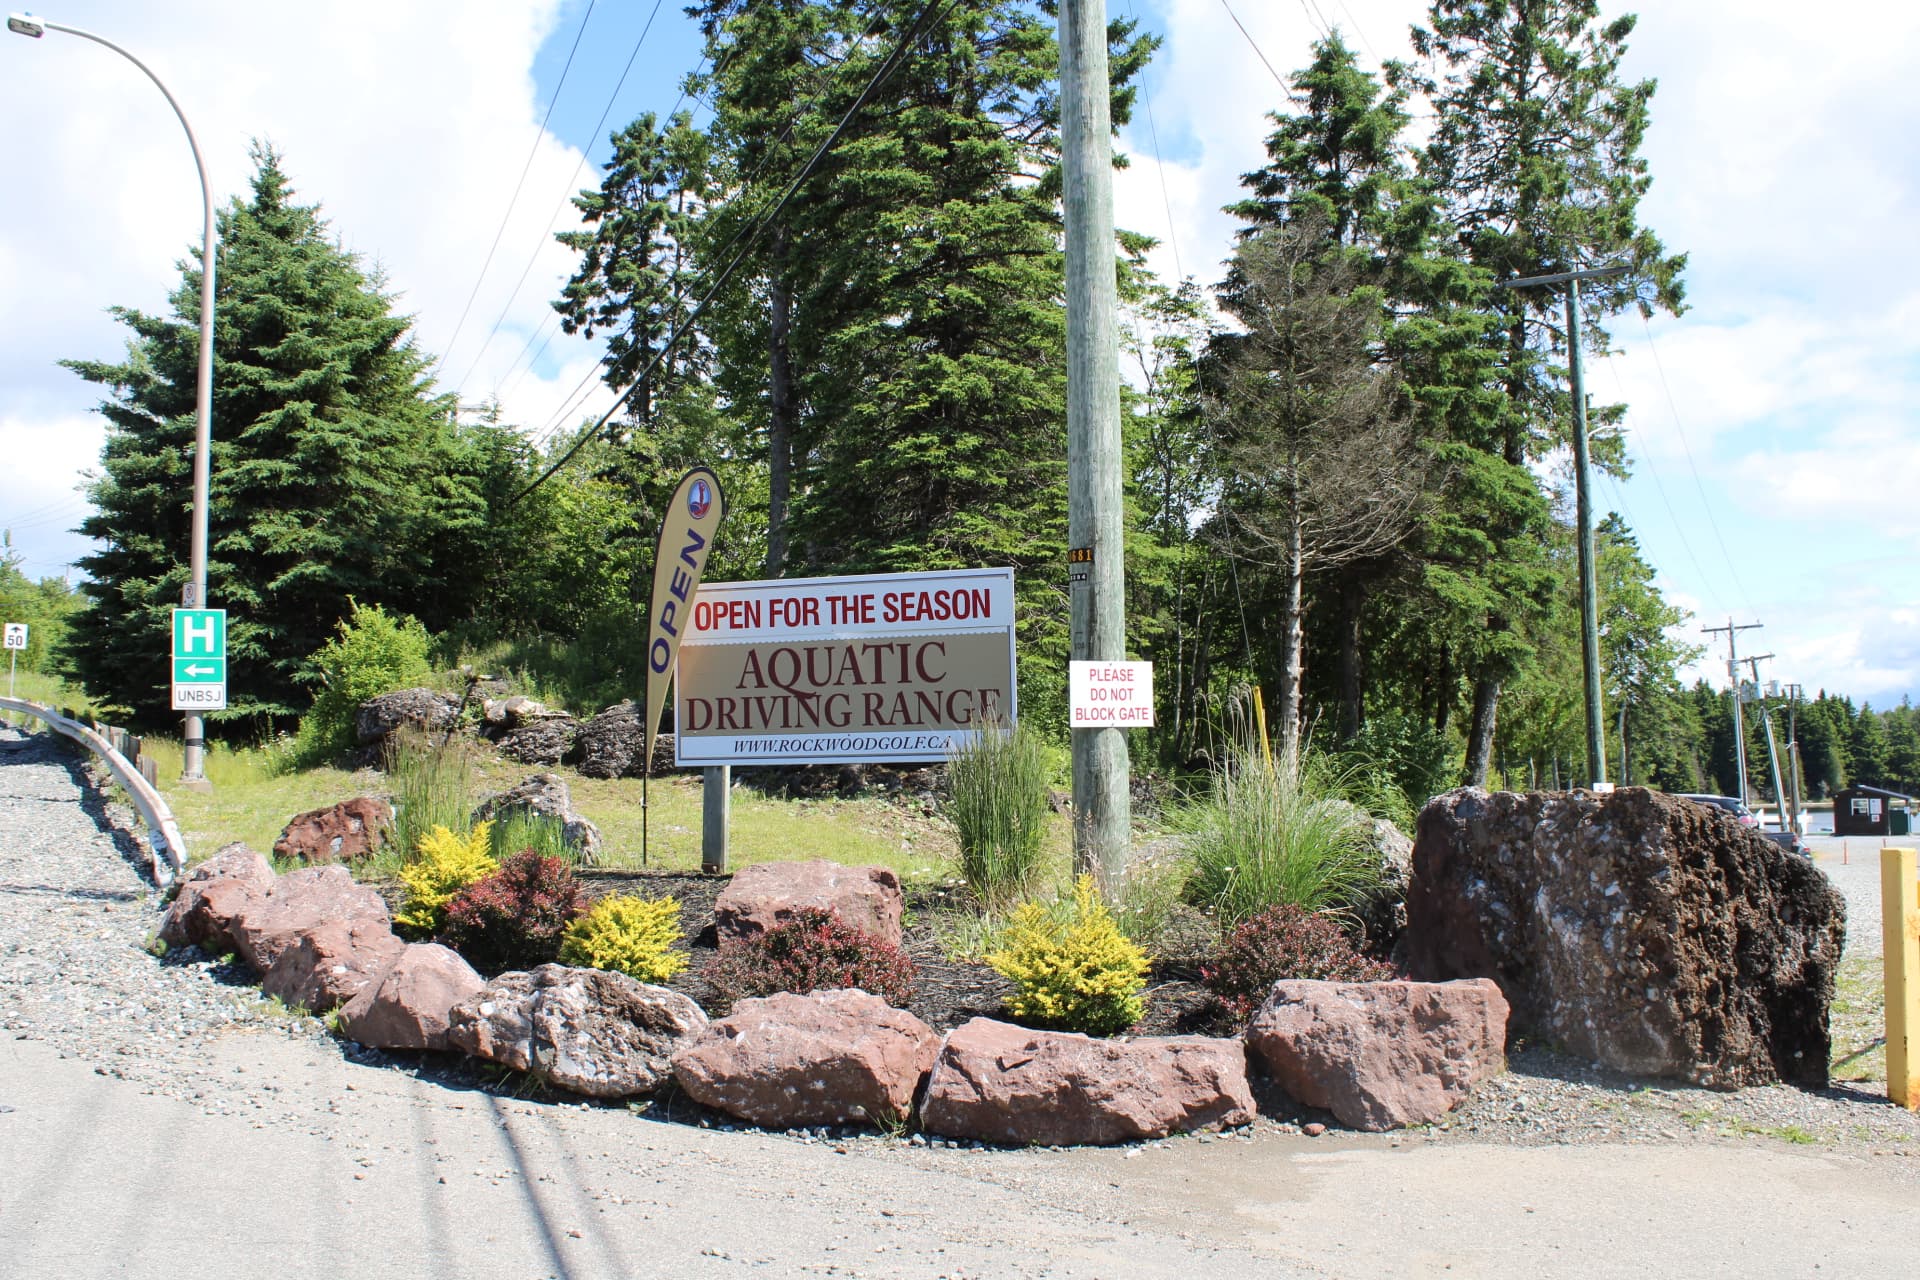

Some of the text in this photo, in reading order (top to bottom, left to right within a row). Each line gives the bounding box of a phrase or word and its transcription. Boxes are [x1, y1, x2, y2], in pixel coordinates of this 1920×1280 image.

[650, 527, 706, 674] OPEN
[694, 588, 991, 631] OPEN FOR THE SEASON
[7, 635, 23, 646] 50
[183, 615, 215, 653] H
[735, 640, 948, 700] AQUATIC
[1089, 668, 1135, 682] PLEASE
[177, 689, 222, 702] UNBSJ
[1090, 687, 1134, 701] DO NOT
[685, 688, 1004, 731] DRIVING RANGE
[1075, 707, 1149, 721] BLOCK GATE
[733, 735, 952, 754] WWW.ROCKWOODGOLF.CA
